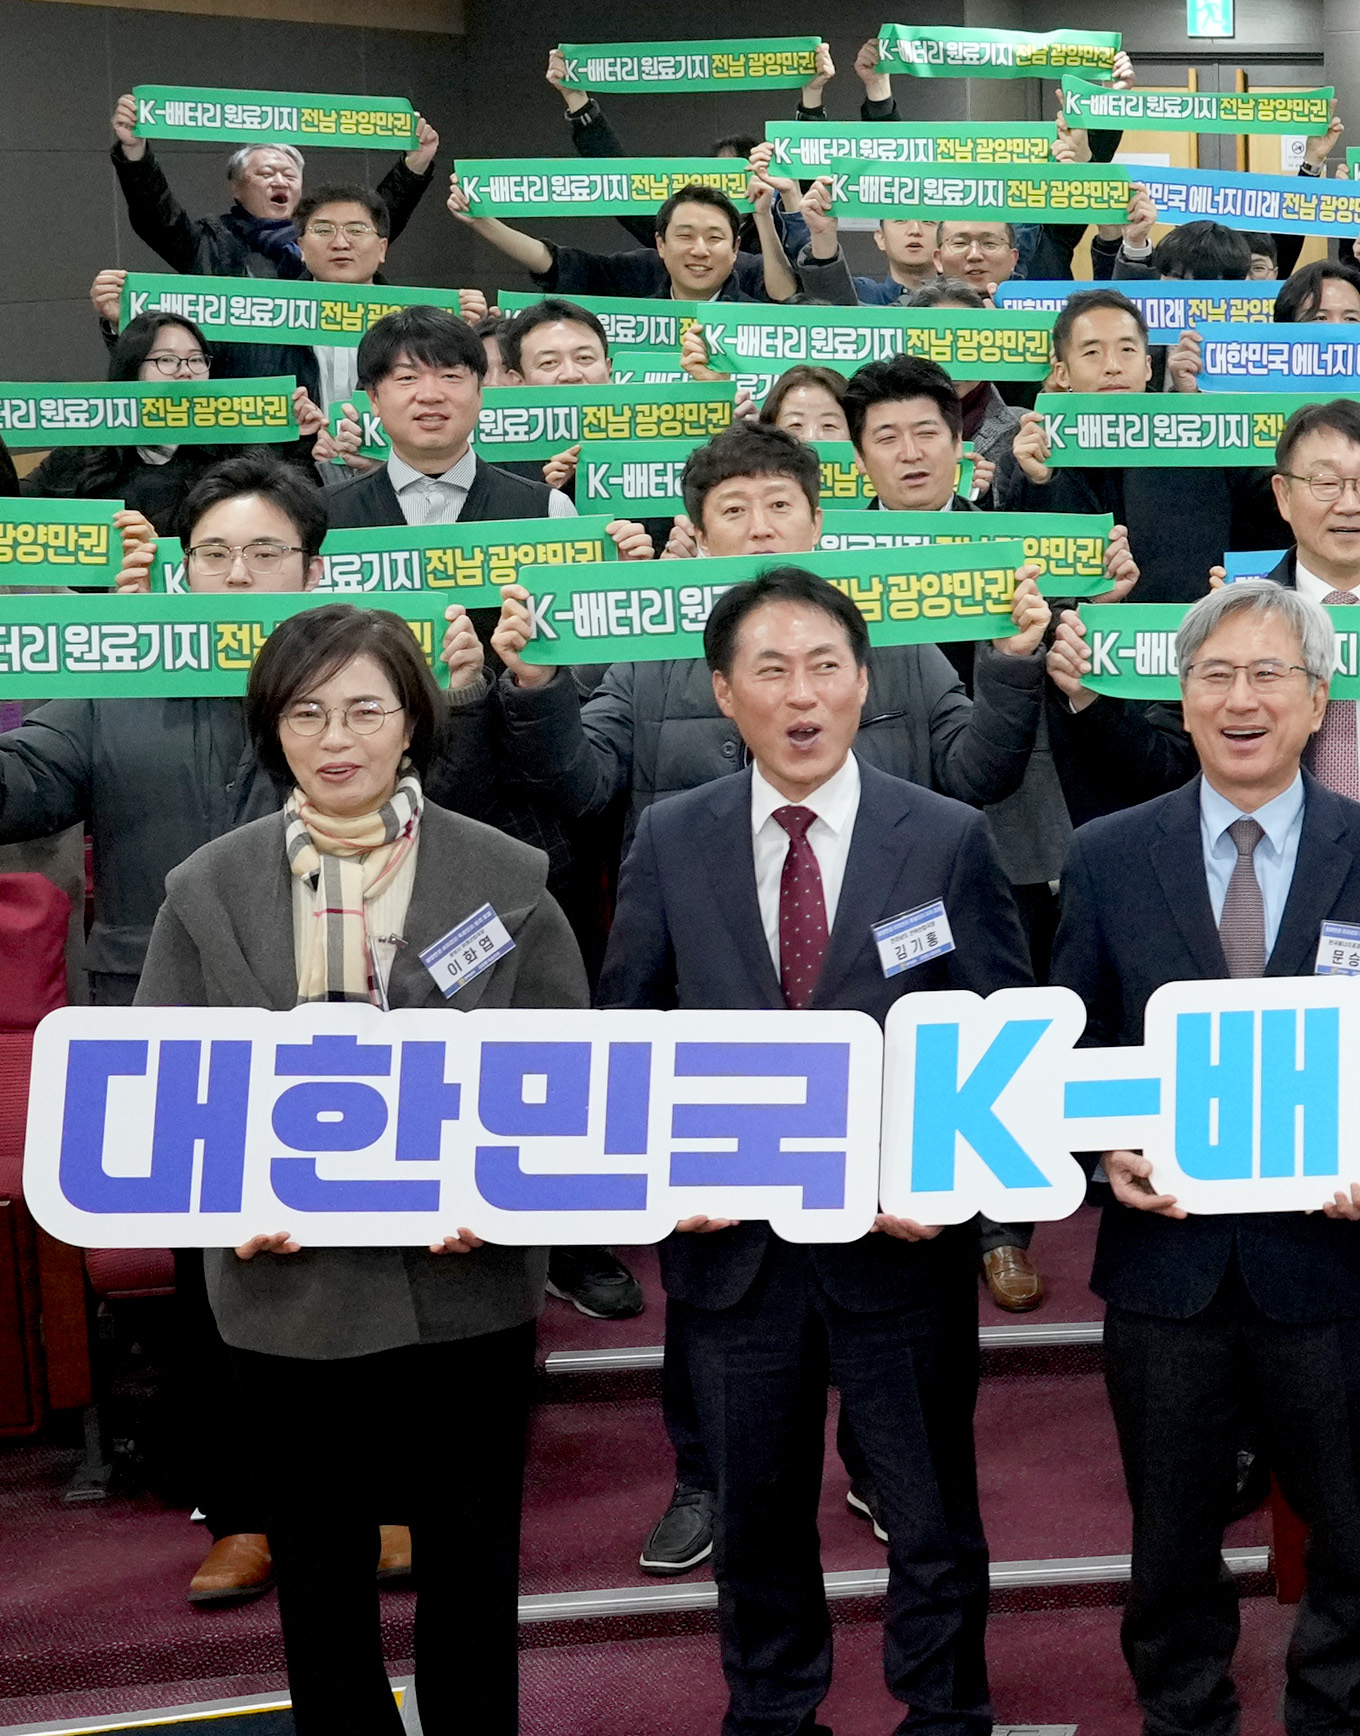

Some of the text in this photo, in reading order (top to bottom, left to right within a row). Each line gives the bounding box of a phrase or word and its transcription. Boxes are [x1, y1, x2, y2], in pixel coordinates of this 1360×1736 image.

[564, 51, 817, 82] K-배터리 원료기지 전남 광양만권
[878, 37, 1116, 69] K-배터리 원료기지 전남 광양만권
[139, 98, 413, 137] K-배터리 원료기지 전남 광양만권
[1064, 92, 1329, 123] K-배터리 원료기지 전남 광양만권
[774, 136, 857, 164] K-배터리
[463, 173, 669, 204] K-배터리 원료기지 전남
[831, 174, 1132, 208] K-배터리 원료기지 광양만권
[1281, 193, 1317, 220] 전남
[229, 297, 318, 330] 원료기지
[320, 301, 362, 332] 전남
[706, 323, 1050, 364] K-배터리 원료기지 전남 광양만권
[1205, 342, 1292, 375] 대한민국
[40, 398, 138, 428] 원료기지
[141, 397, 192, 427] 전남
[193, 396, 289, 427] 광양만권
[478, 400, 732, 443] 원료기지 전남 광양만권
[1046, 412, 1251, 449] K-배터리 원료기지
[425, 548, 484, 588] 전남
[525, 590, 675, 639] K-배터리
[887, 569, 1016, 620] 광양만권
[64, 622, 210, 672] 원료기지
[59, 1034, 851, 1214] 대한민국
